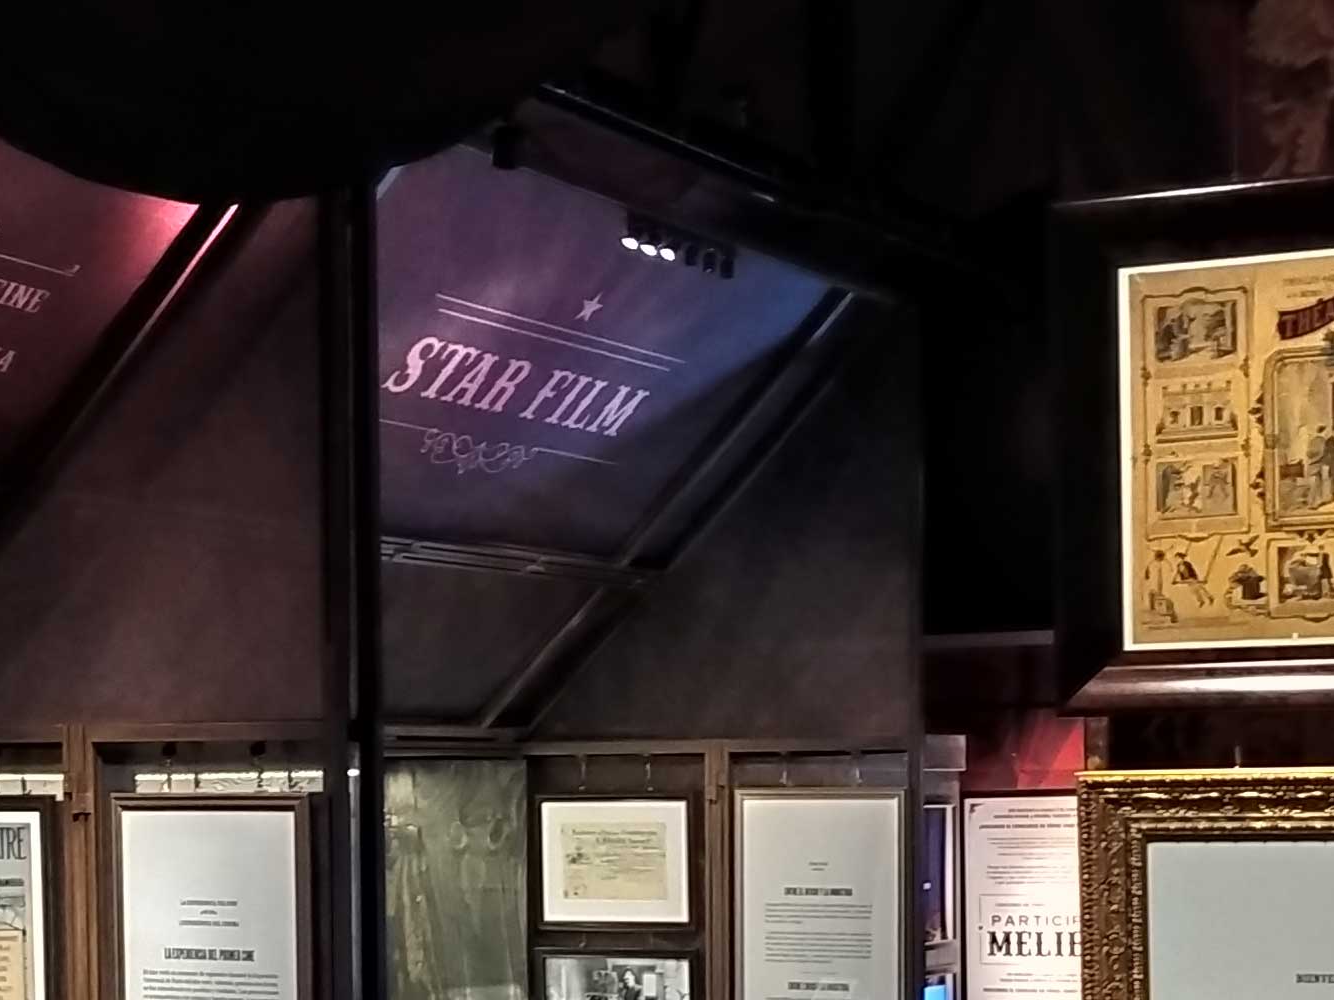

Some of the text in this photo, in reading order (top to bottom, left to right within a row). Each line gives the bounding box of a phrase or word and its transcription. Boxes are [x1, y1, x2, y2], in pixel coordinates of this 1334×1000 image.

[381, 336, 650, 436] STAR FILM
[991, 914, 1082, 927] PARTICIP
[987, 930, 1083, 957] MELIE
